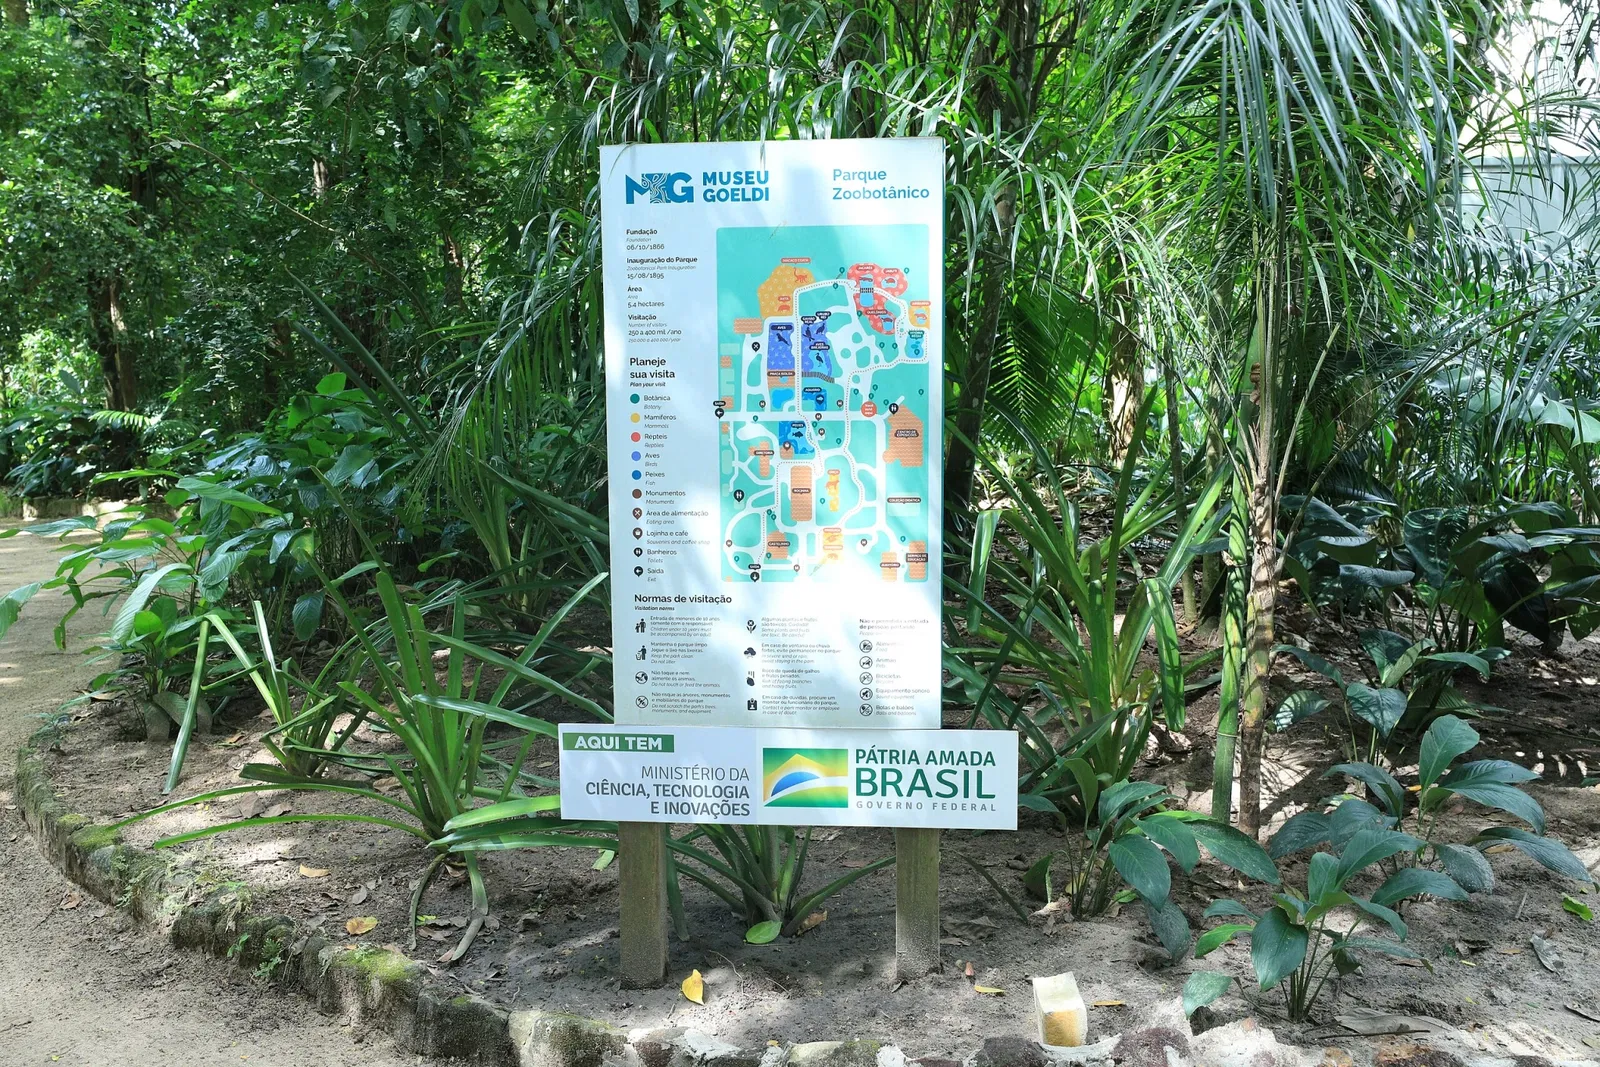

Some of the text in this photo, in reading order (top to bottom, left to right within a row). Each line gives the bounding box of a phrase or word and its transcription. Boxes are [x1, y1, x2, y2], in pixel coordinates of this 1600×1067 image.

[703, 171, 769, 186] MUSEU
[833, 168, 887, 184] Parque
[703, 187, 770, 202] GOELDI
[832, 186, 930, 200] Zoobotânico
[626, 257, 665, 265] Inauguração
[630, 357, 666, 367] Planeje
[650, 370, 675, 378] visita
[635, 594, 732, 605] Normas de visitação
[574, 736, 662, 750] AQUI TEM
[855, 745, 996, 766] PÁTRIA AMADA
[641, 764, 749, 781] MINISTÉRIO DA
[586, 778, 750, 799] CIÊNCIA, TECNOLOGIA
[855, 767, 996, 799] BRASIL
[651, 800, 750, 819] E INOVAÇÕES
[856, 801, 996, 812] GOVERNO FEDERAL
